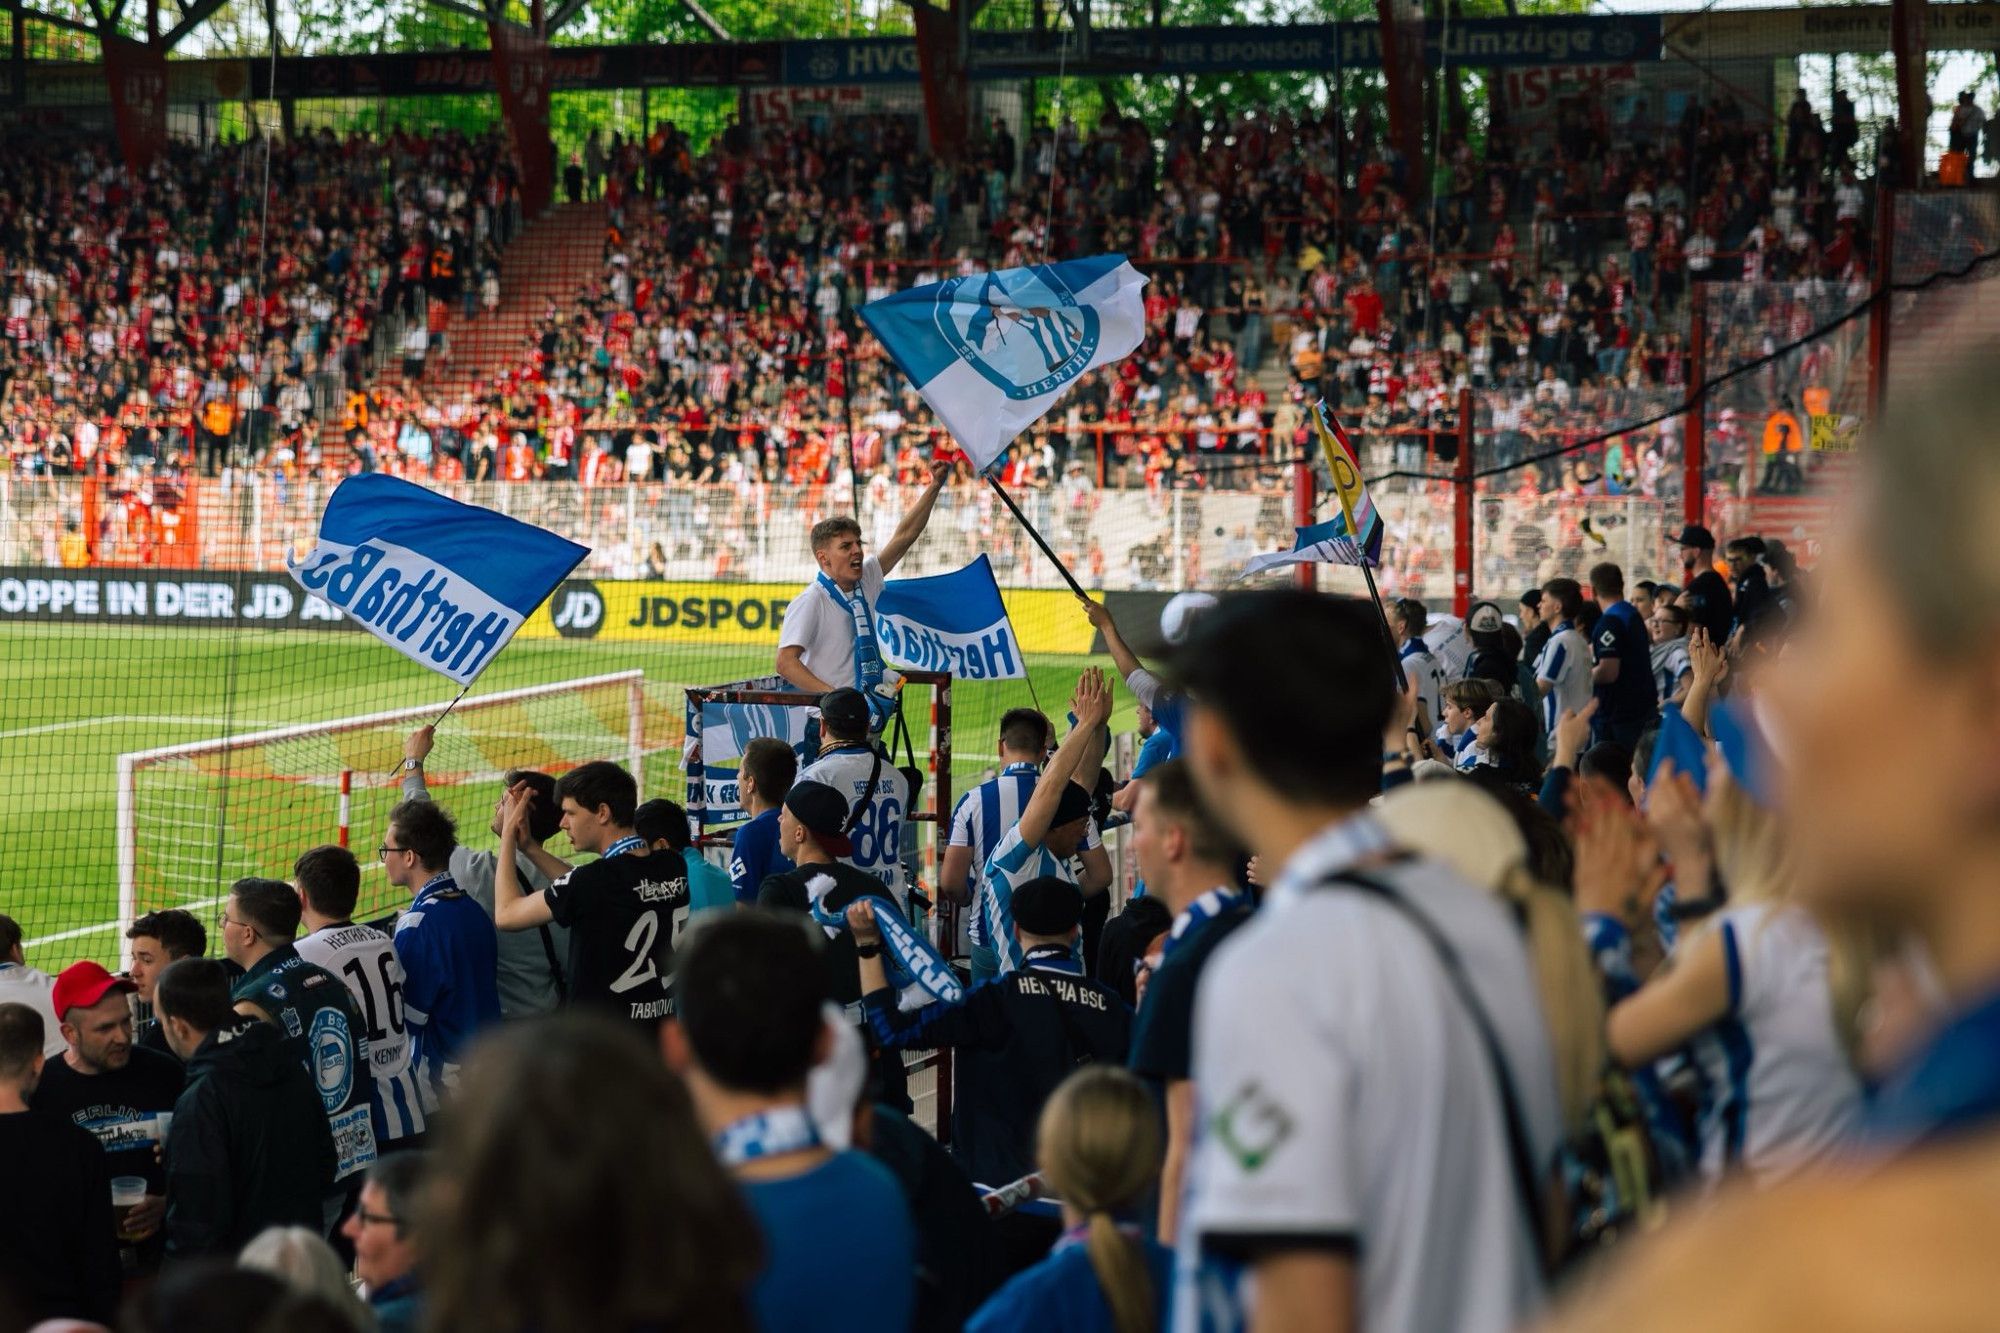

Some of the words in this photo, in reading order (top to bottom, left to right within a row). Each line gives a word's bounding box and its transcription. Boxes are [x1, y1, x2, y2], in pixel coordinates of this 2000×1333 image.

[1211, 40, 1322, 62] SPONSOR
[1025, 345, 1094, 396] HERTHA
[106, 580, 147, 616] IN
[155, 581, 235, 618] DER
[241, 583, 294, 619] JD
[554, 591, 603, 629] JD
[850, 796, 901, 868] 86
[342, 951, 405, 1041] 16
[1079, 986, 1108, 1011] BSC
